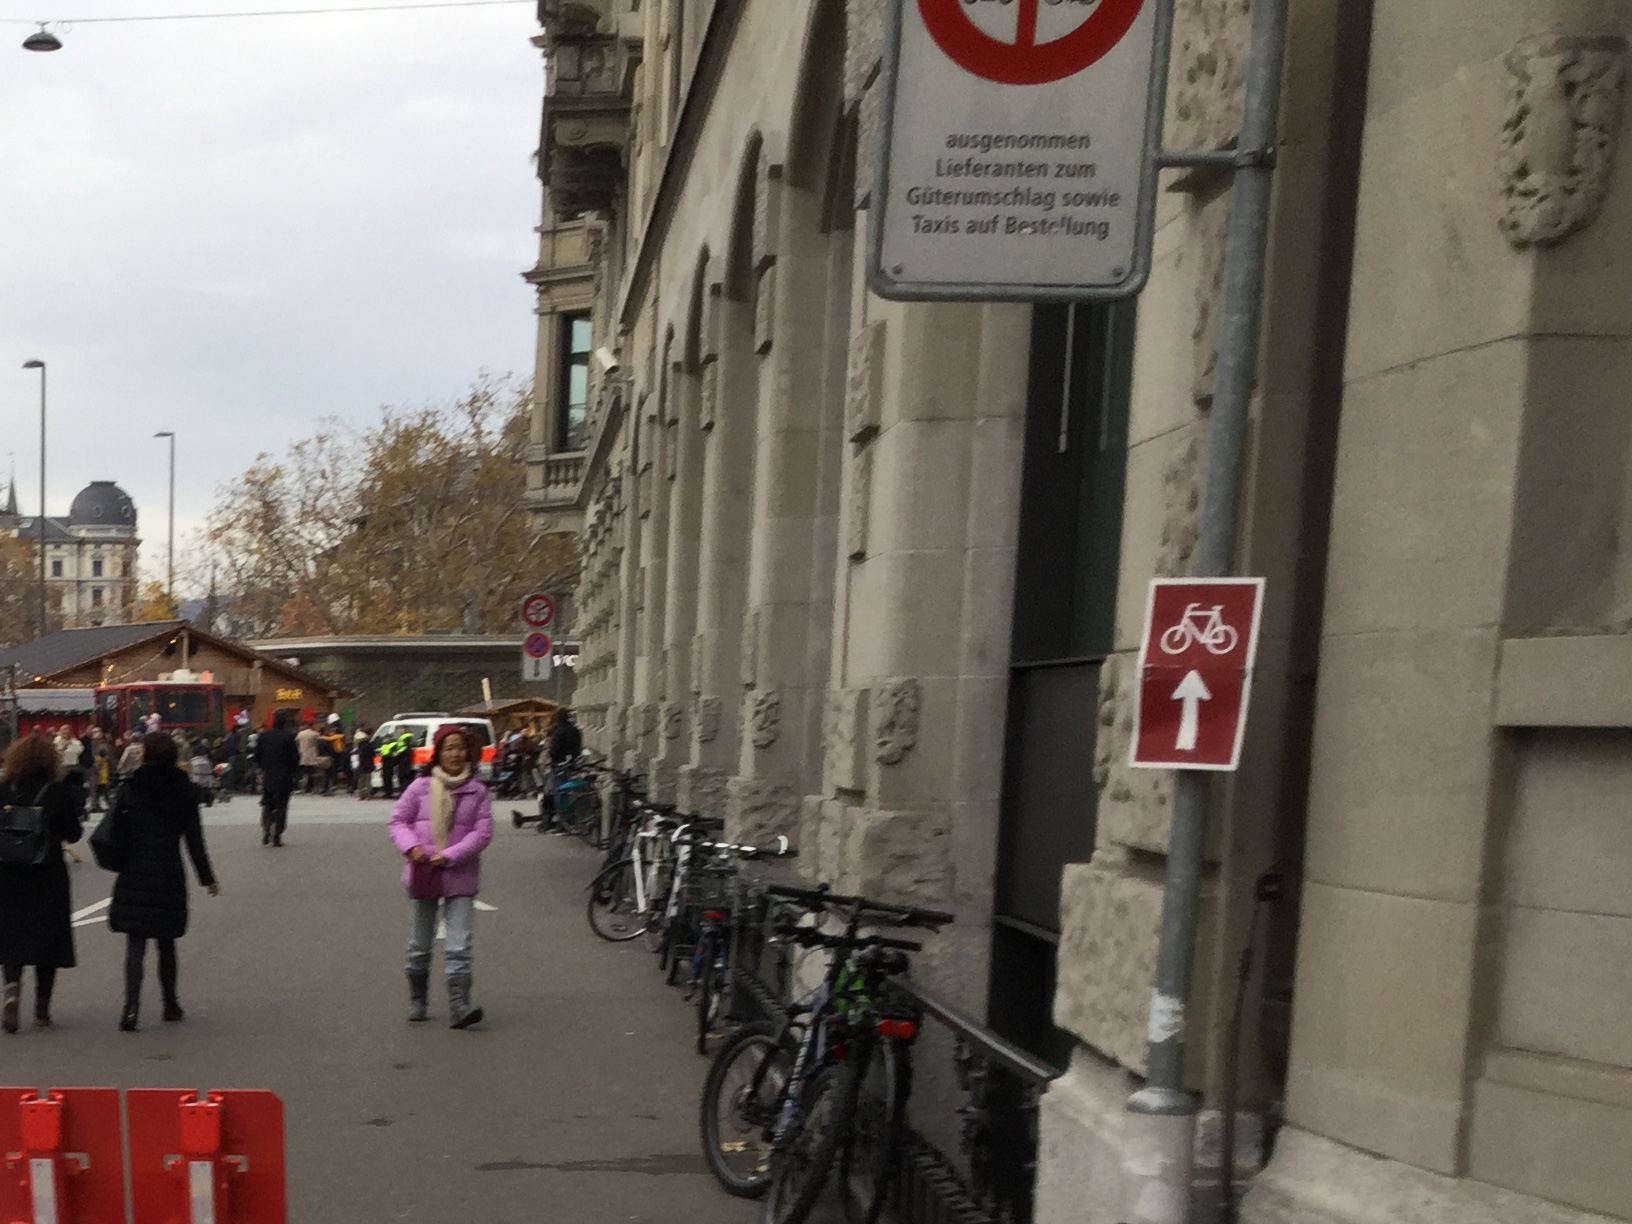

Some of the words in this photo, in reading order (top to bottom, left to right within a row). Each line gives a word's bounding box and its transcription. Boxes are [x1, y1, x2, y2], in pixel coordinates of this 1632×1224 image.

[945, 133, 1091, 153] ausgenommen
[935, 157, 1048, 178] Lieferanten
[1054, 162, 1096, 178] zum
[907, 185, 1055, 211] Güterumschlag
[1062, 189, 1121, 207] sowie
[912, 214, 960, 234] Taxis
[966, 214, 1000, 234] auf
[1005, 215, 1110, 241] Bestellung
